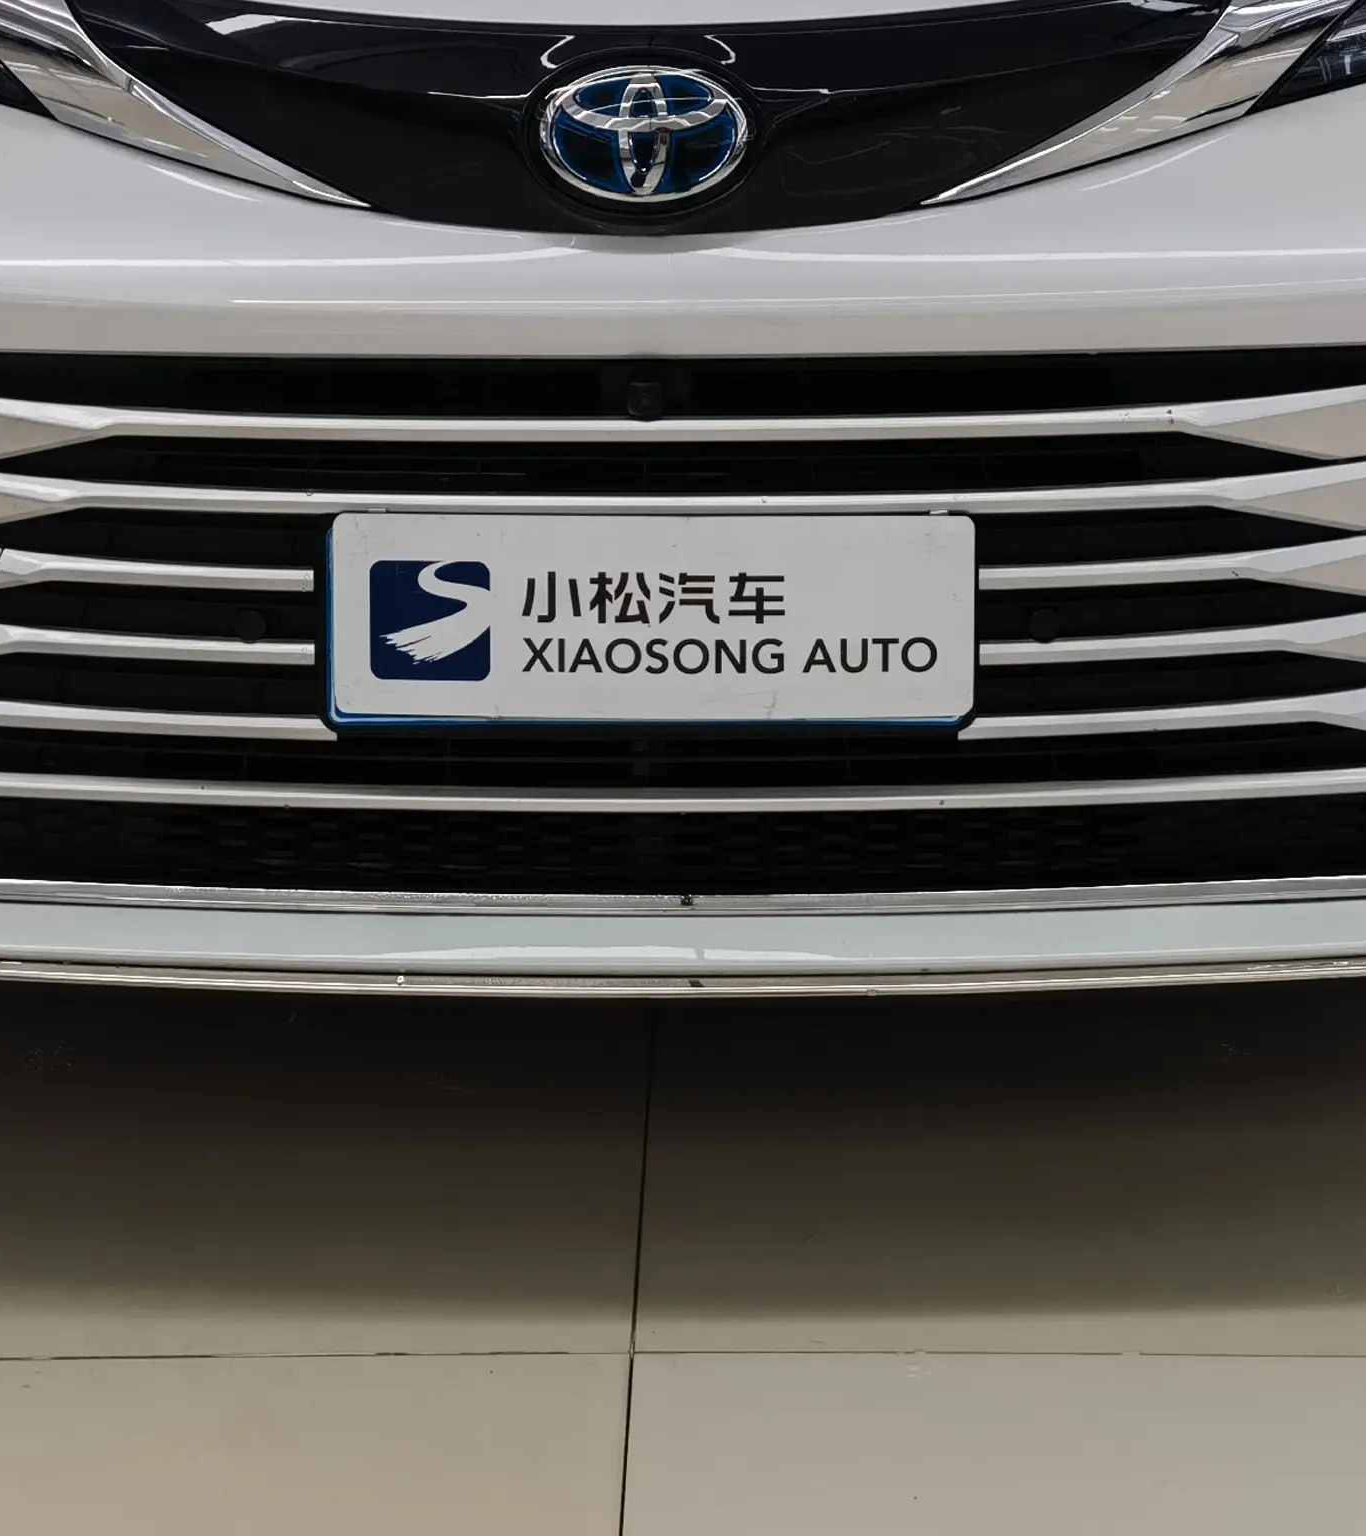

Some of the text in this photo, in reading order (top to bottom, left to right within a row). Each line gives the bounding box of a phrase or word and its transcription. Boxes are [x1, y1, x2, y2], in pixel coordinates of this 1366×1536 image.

[520, 571, 787, 625] 小松汽车
[521, 636, 938, 674] XIAOSONG AUTO
